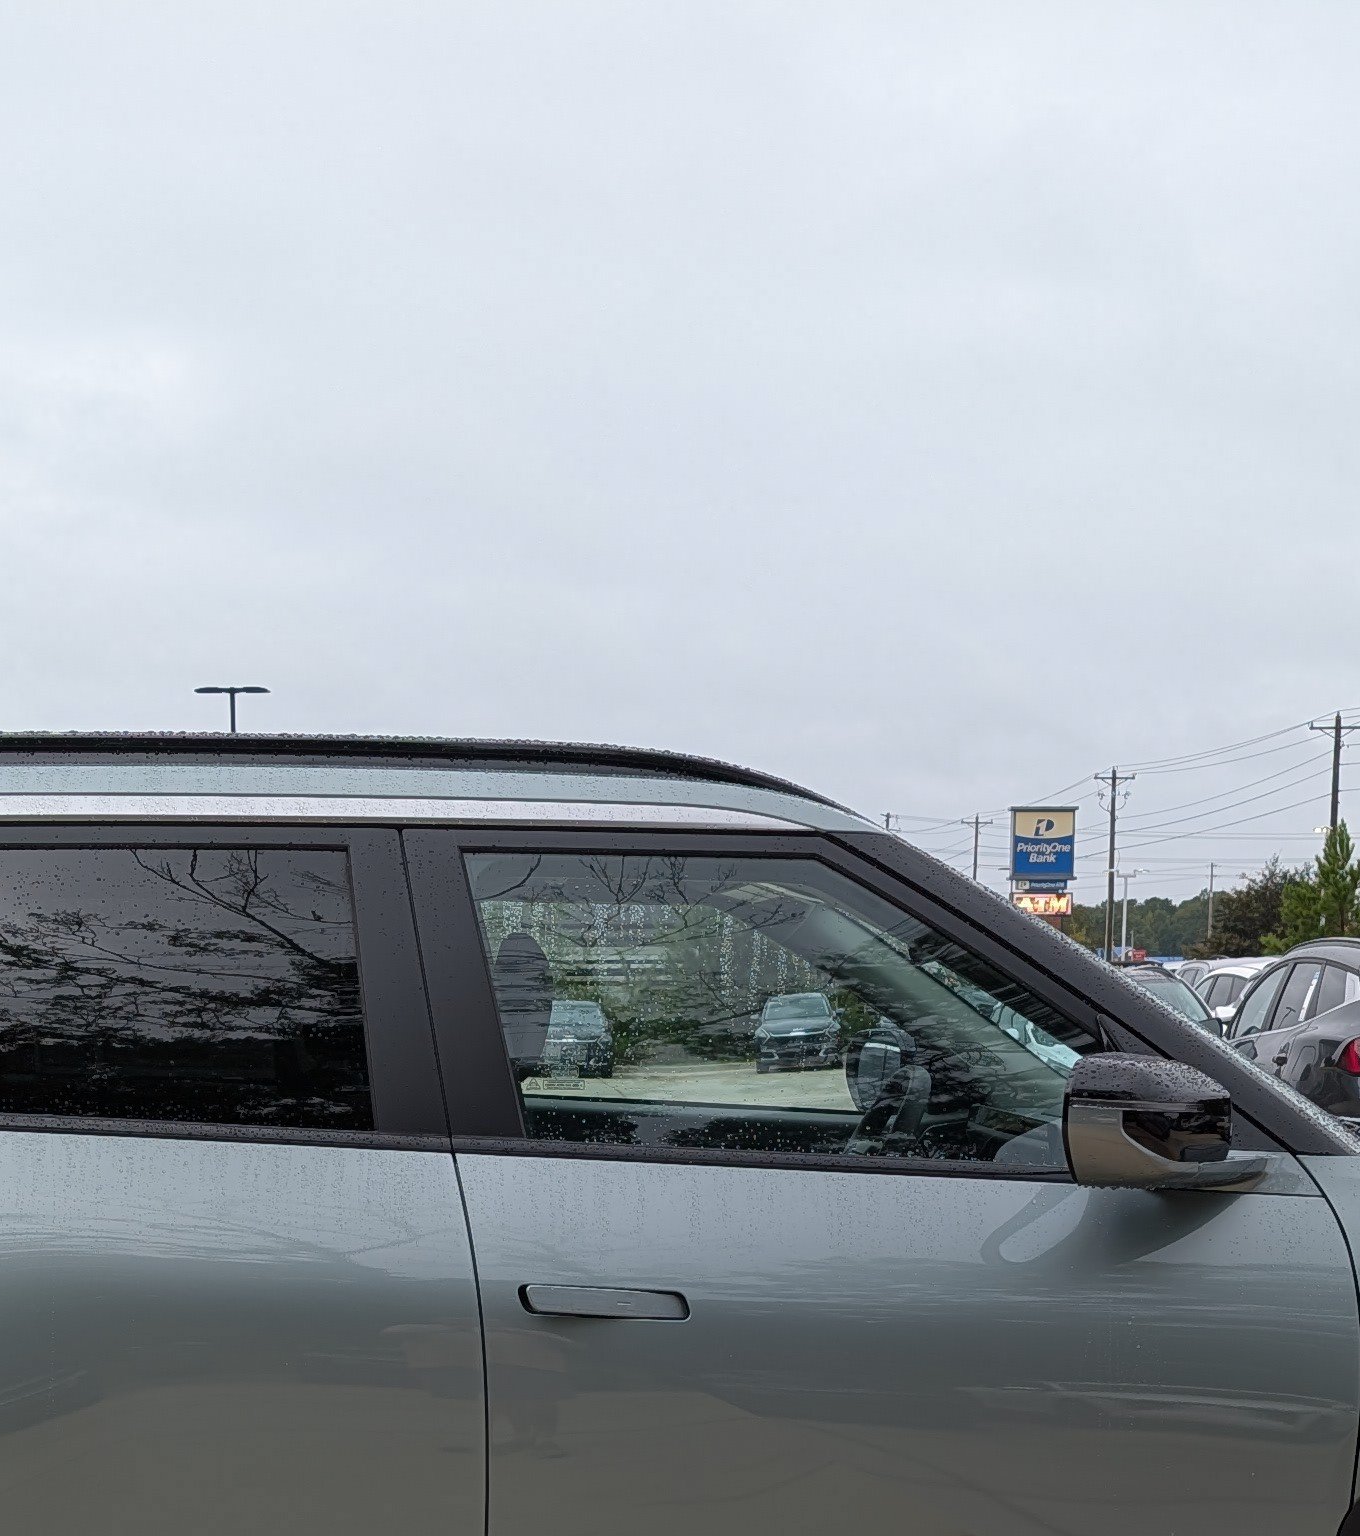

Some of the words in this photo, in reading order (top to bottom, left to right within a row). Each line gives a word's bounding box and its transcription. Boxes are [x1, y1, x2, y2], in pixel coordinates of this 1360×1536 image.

[1017, 843, 1071, 854] PriorityOne
[1029, 853, 1057, 862] Bank
[1016, 896, 1069, 912] ATM
